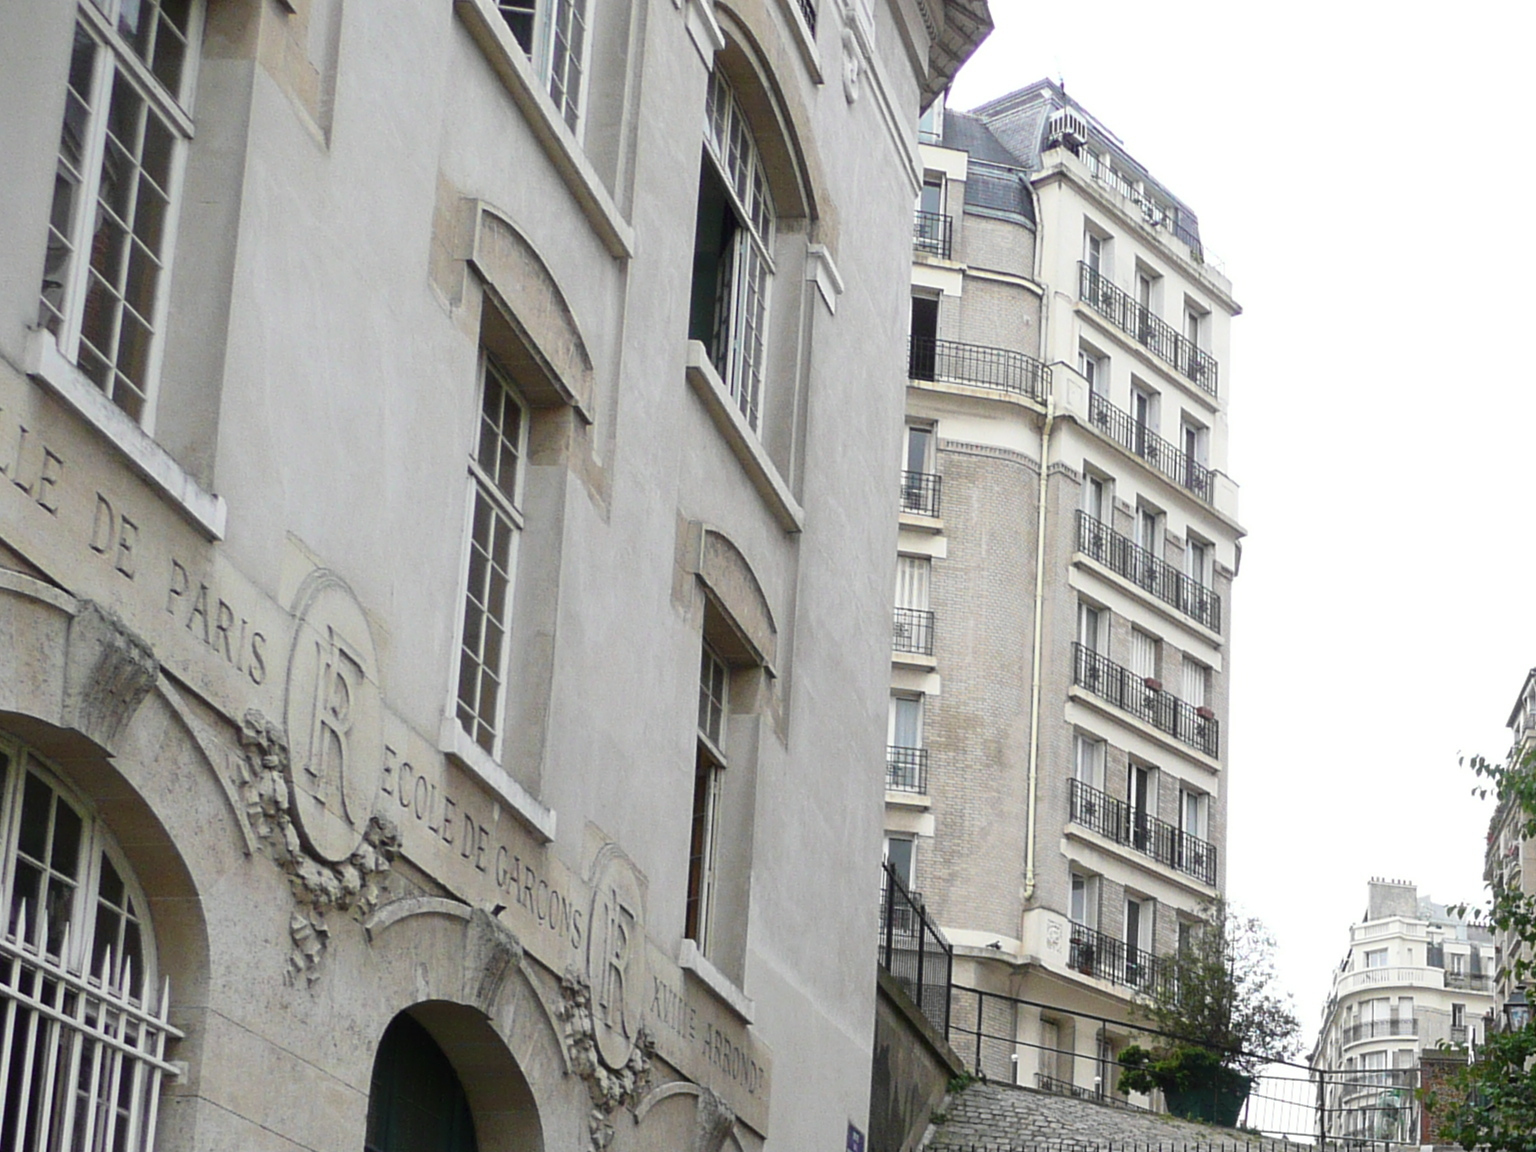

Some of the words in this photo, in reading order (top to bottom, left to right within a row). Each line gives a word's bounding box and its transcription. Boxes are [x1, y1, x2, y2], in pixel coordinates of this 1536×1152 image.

[89, 488, 139, 580] DE
[165, 558, 267, 687] PARIS
[382, 744, 457, 846] ECOLE
[461, 812, 490, 874] DE
